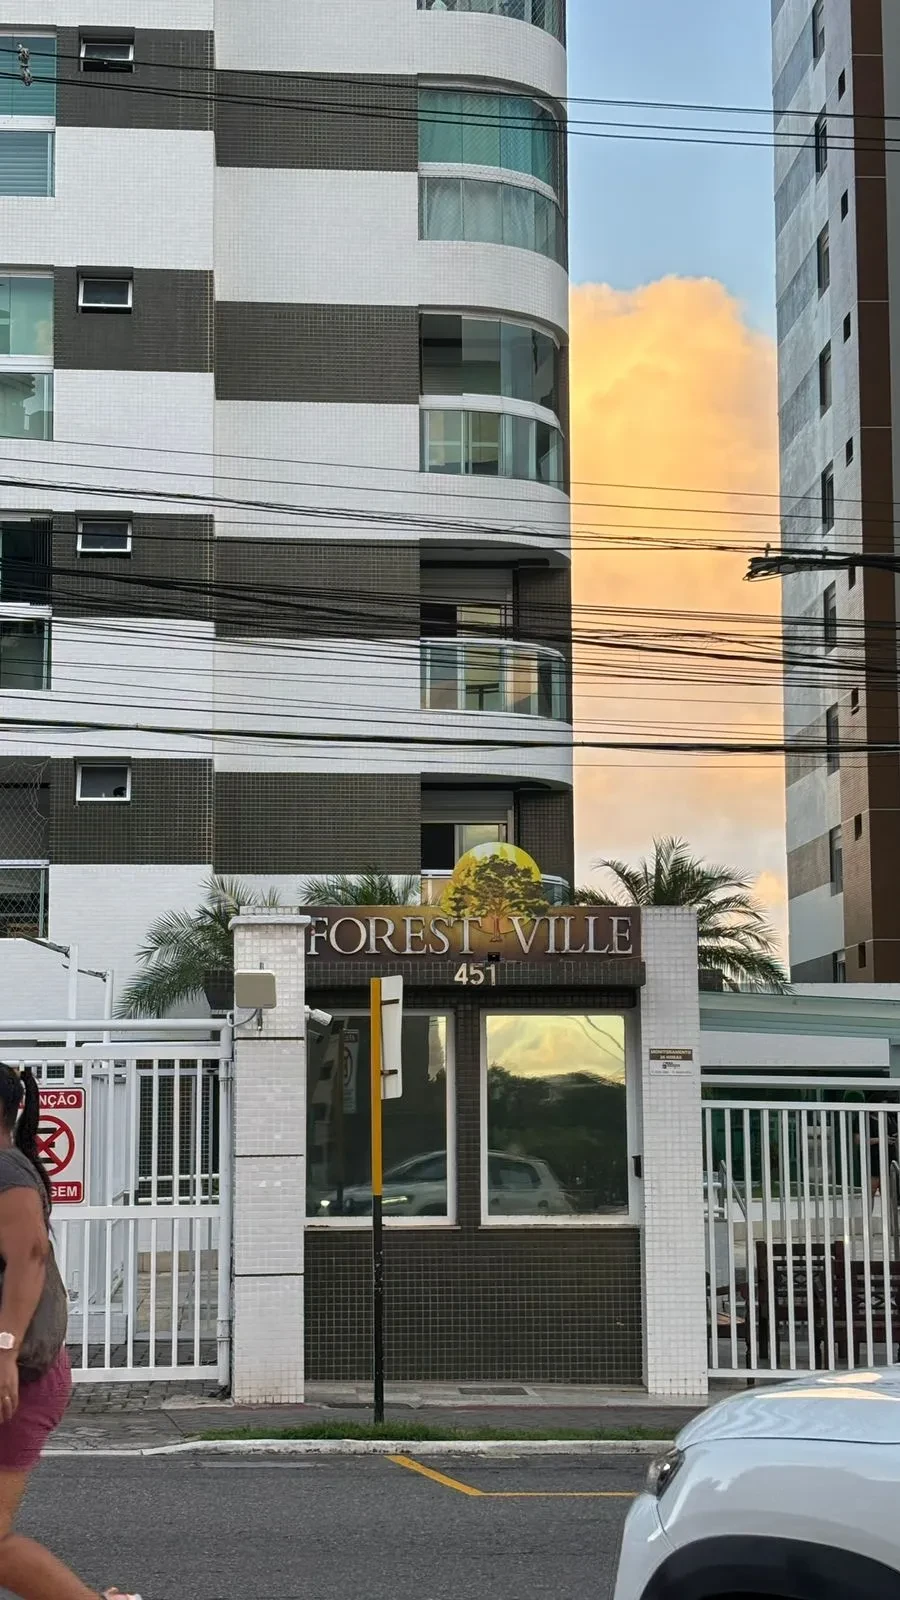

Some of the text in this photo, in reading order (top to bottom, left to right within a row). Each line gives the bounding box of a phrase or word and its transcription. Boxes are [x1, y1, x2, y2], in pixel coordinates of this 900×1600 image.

[306, 915, 633, 955] FOREST VILLE
[454, 962, 496, 986] 451
[39, 1092, 77, 1108] NÇÃO
